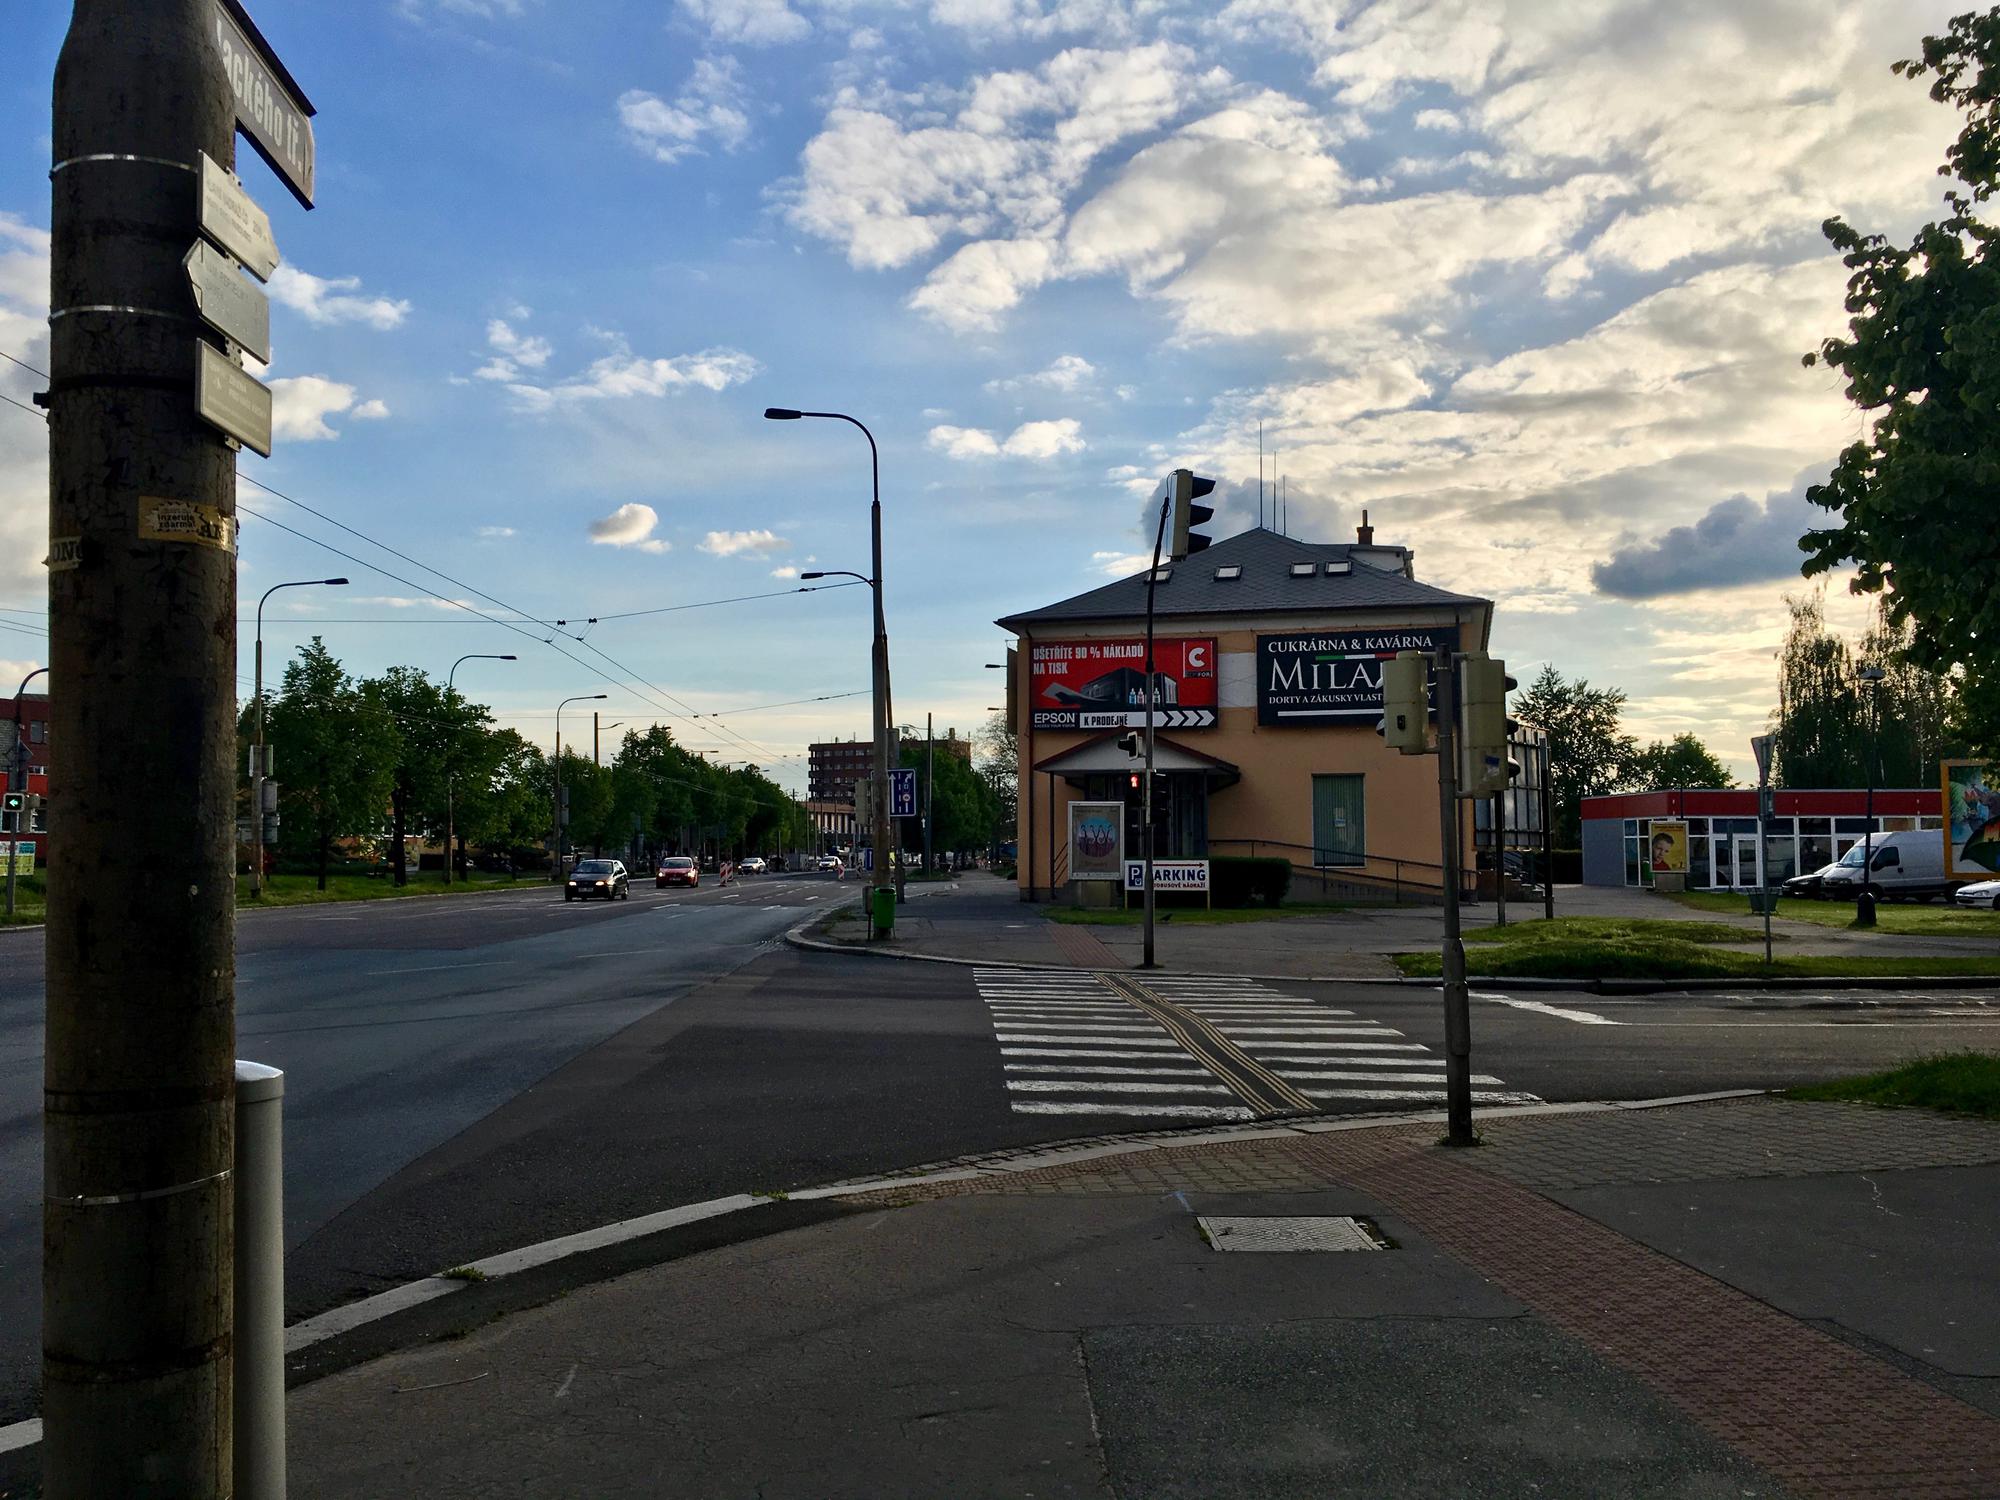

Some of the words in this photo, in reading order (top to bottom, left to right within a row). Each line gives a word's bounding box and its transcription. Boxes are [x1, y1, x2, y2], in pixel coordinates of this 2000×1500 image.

[1267, 637, 1347, 653] CUKRÁRNA
[1350, 638, 1362, 650] &
[1365, 634, 1433, 650] KAVÁRNA
[1033, 645, 1073, 660] UŠETŘÍTE
[1075, 646, 1087, 659] 90
[1090, 646, 1101, 659] %
[1103, 642, 1144, 658] NÁKLADŮ
[1033, 662, 1045, 675] NA
[1048, 661, 1068, 675] TISK
[1268, 656, 1384, 691] MILA
[1268, 694, 1301, 705] DORTY
[1302, 695, 1309, 704] A
[1310, 692, 1354, 703] ZÁKUSKY
[1354, 693, 1383, 702] VLAST
[1034, 712, 1075, 724] EPSON
[1084, 716, 1090, 726] K
[1154, 869, 1206, 881] ARKING
